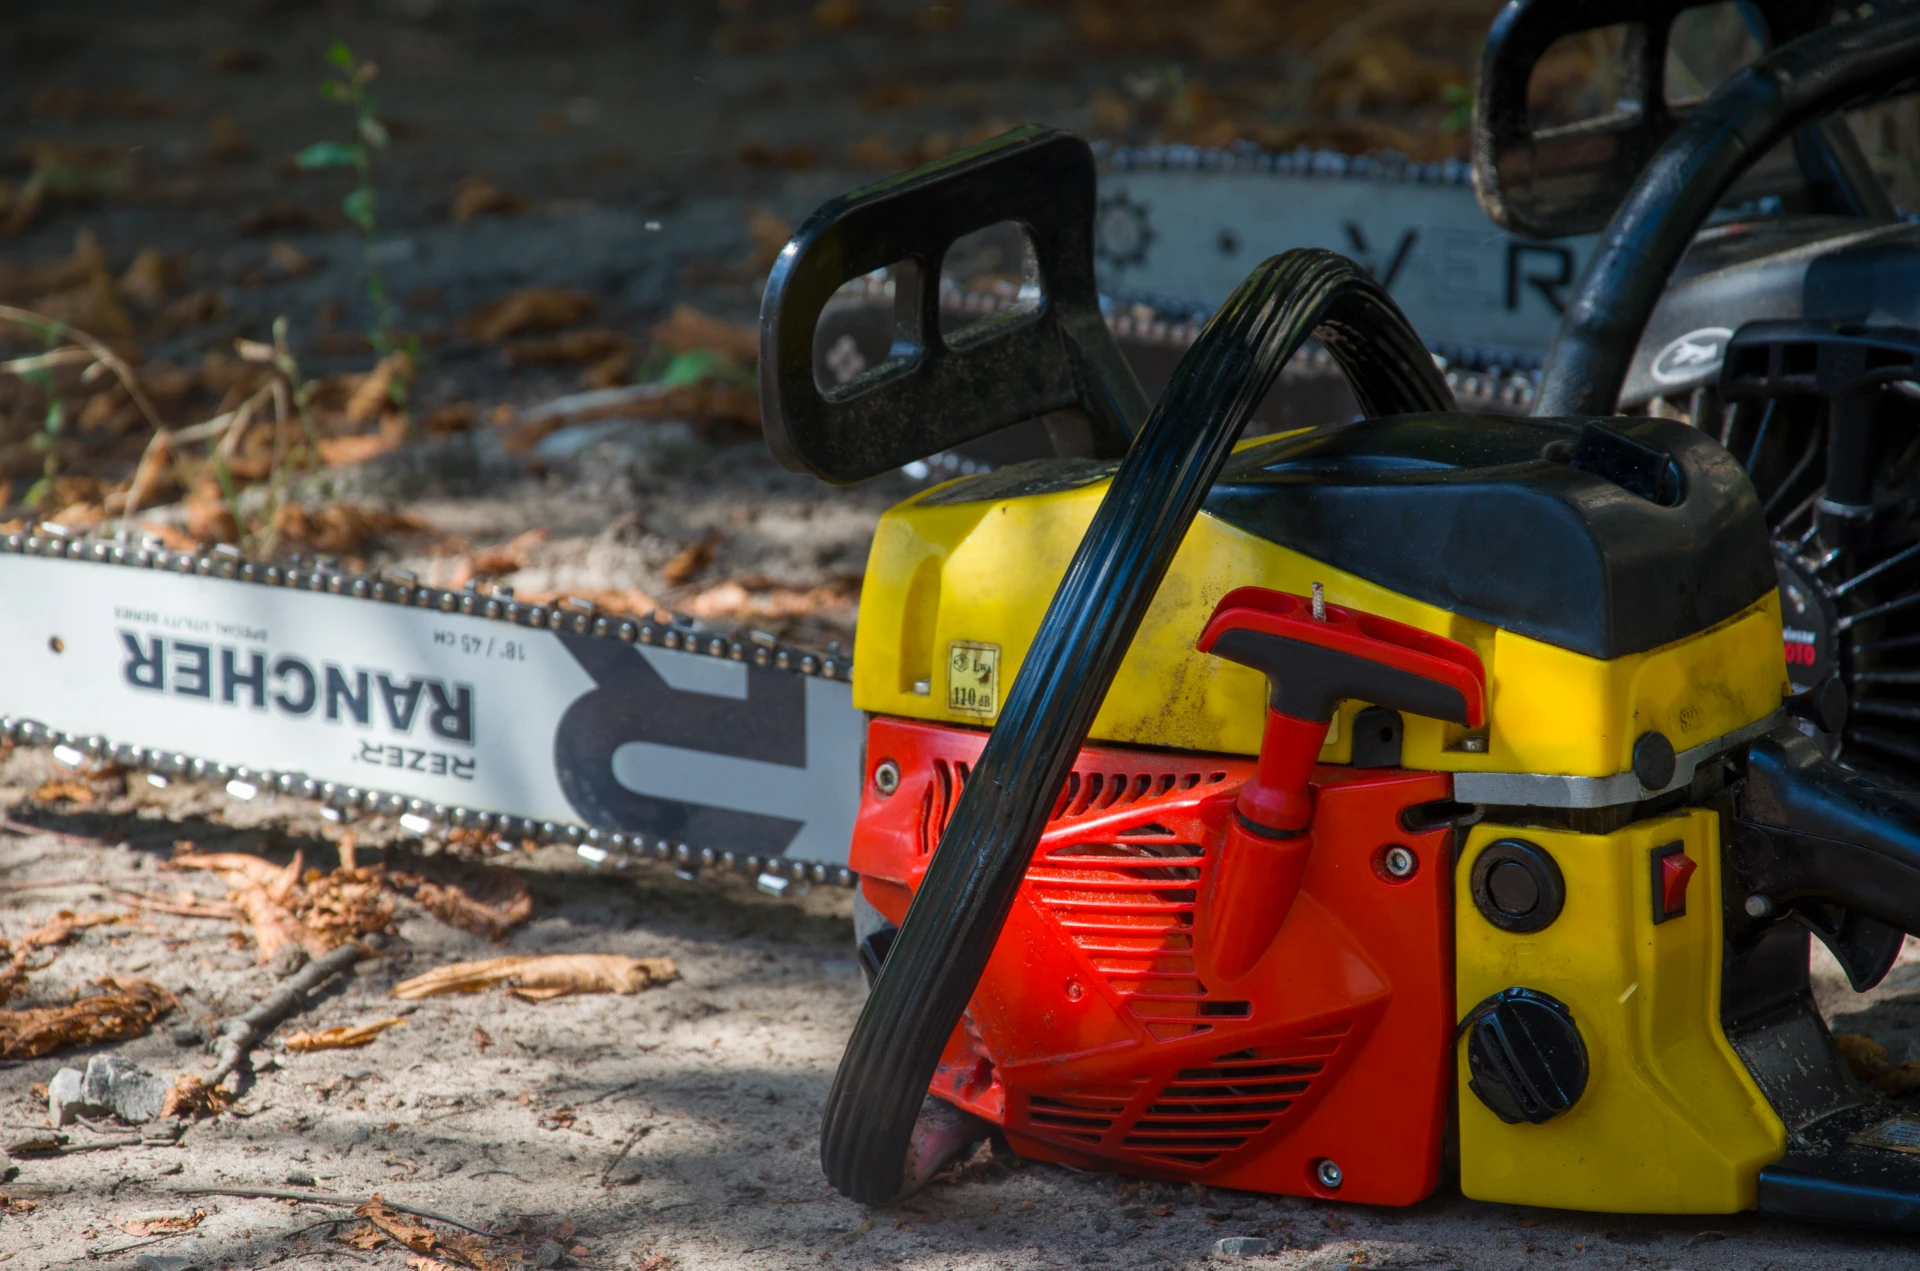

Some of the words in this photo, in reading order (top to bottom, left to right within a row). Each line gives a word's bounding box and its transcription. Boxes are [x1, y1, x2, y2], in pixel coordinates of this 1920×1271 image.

[163, 615, 211, 633] UTILITY
[461, 633, 482, 654] 45
[1784, 642, 1817, 667] OTO
[116, 628, 475, 746] RANCHER
[954, 687, 977, 706] 110
[979, 695, 991, 707] dB
[357, 740, 476, 781] REZER
